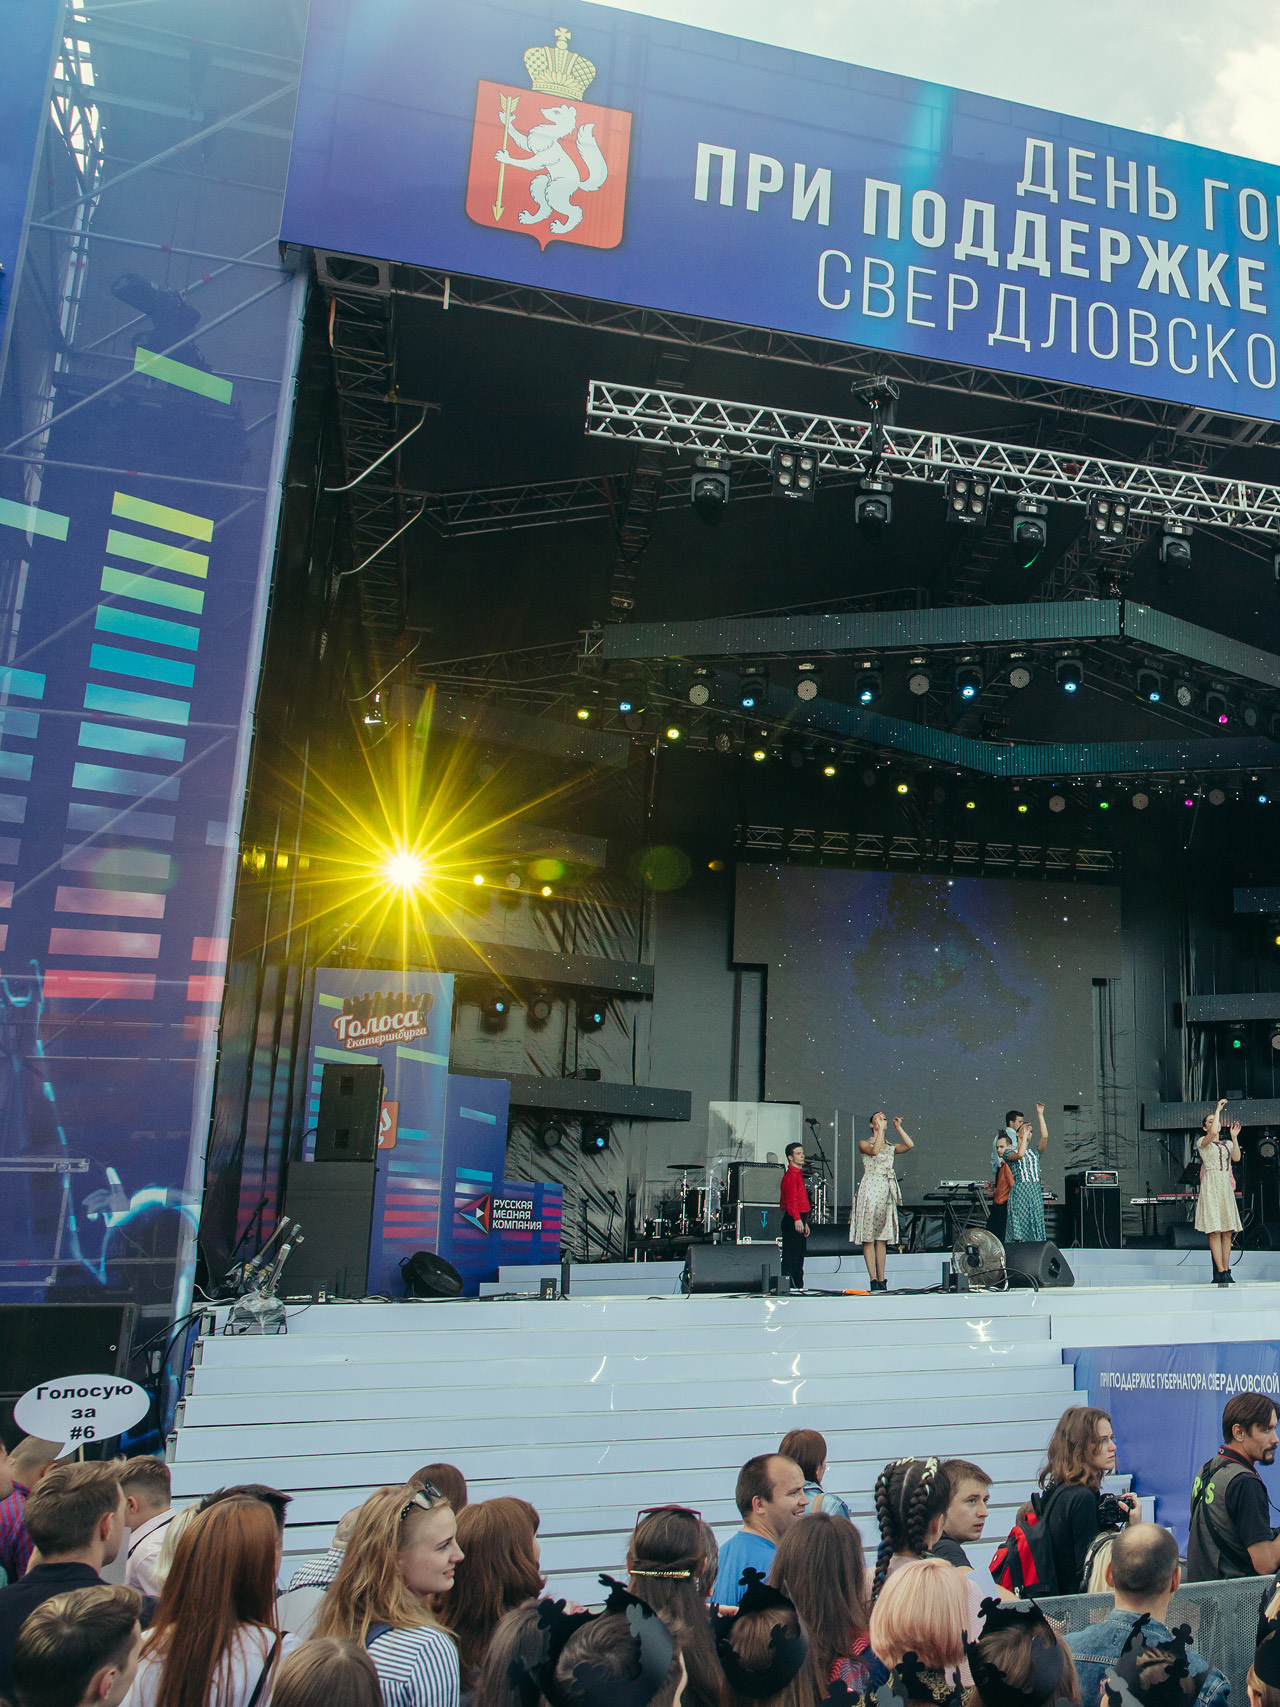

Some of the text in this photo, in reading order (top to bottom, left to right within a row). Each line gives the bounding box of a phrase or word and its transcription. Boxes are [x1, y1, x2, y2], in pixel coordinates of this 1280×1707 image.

[1016, 136, 1177, 221] ДЕНЬ
[693, 141, 833, 226] ПРИ
[862, 177, 1268, 315] ПОДДЕРЖКЕ
[334, 1010, 419, 1039] Голоса
[346, 1027, 426, 1049] Екатеринбурга
[493, 1199, 533, 1210] РУССКАЯ
[493, 1209, 531, 1219] МЕДНАЯ
[492, 1219, 542, 1230] КОМПАНИЯ
[1109, 1372, 1156, 1391] ПОДДЕРЖКЕ
[1157, 1372, 1208, 1391] ГУБЕРНАТОРА
[1207, 1372, 1280, 1395] СЕРДЛОВСКОЙ
[36, 1385, 134, 1401] Голосую
[71, 1408, 96, 1419] за
[70, 1426, 95, 1440] #6
